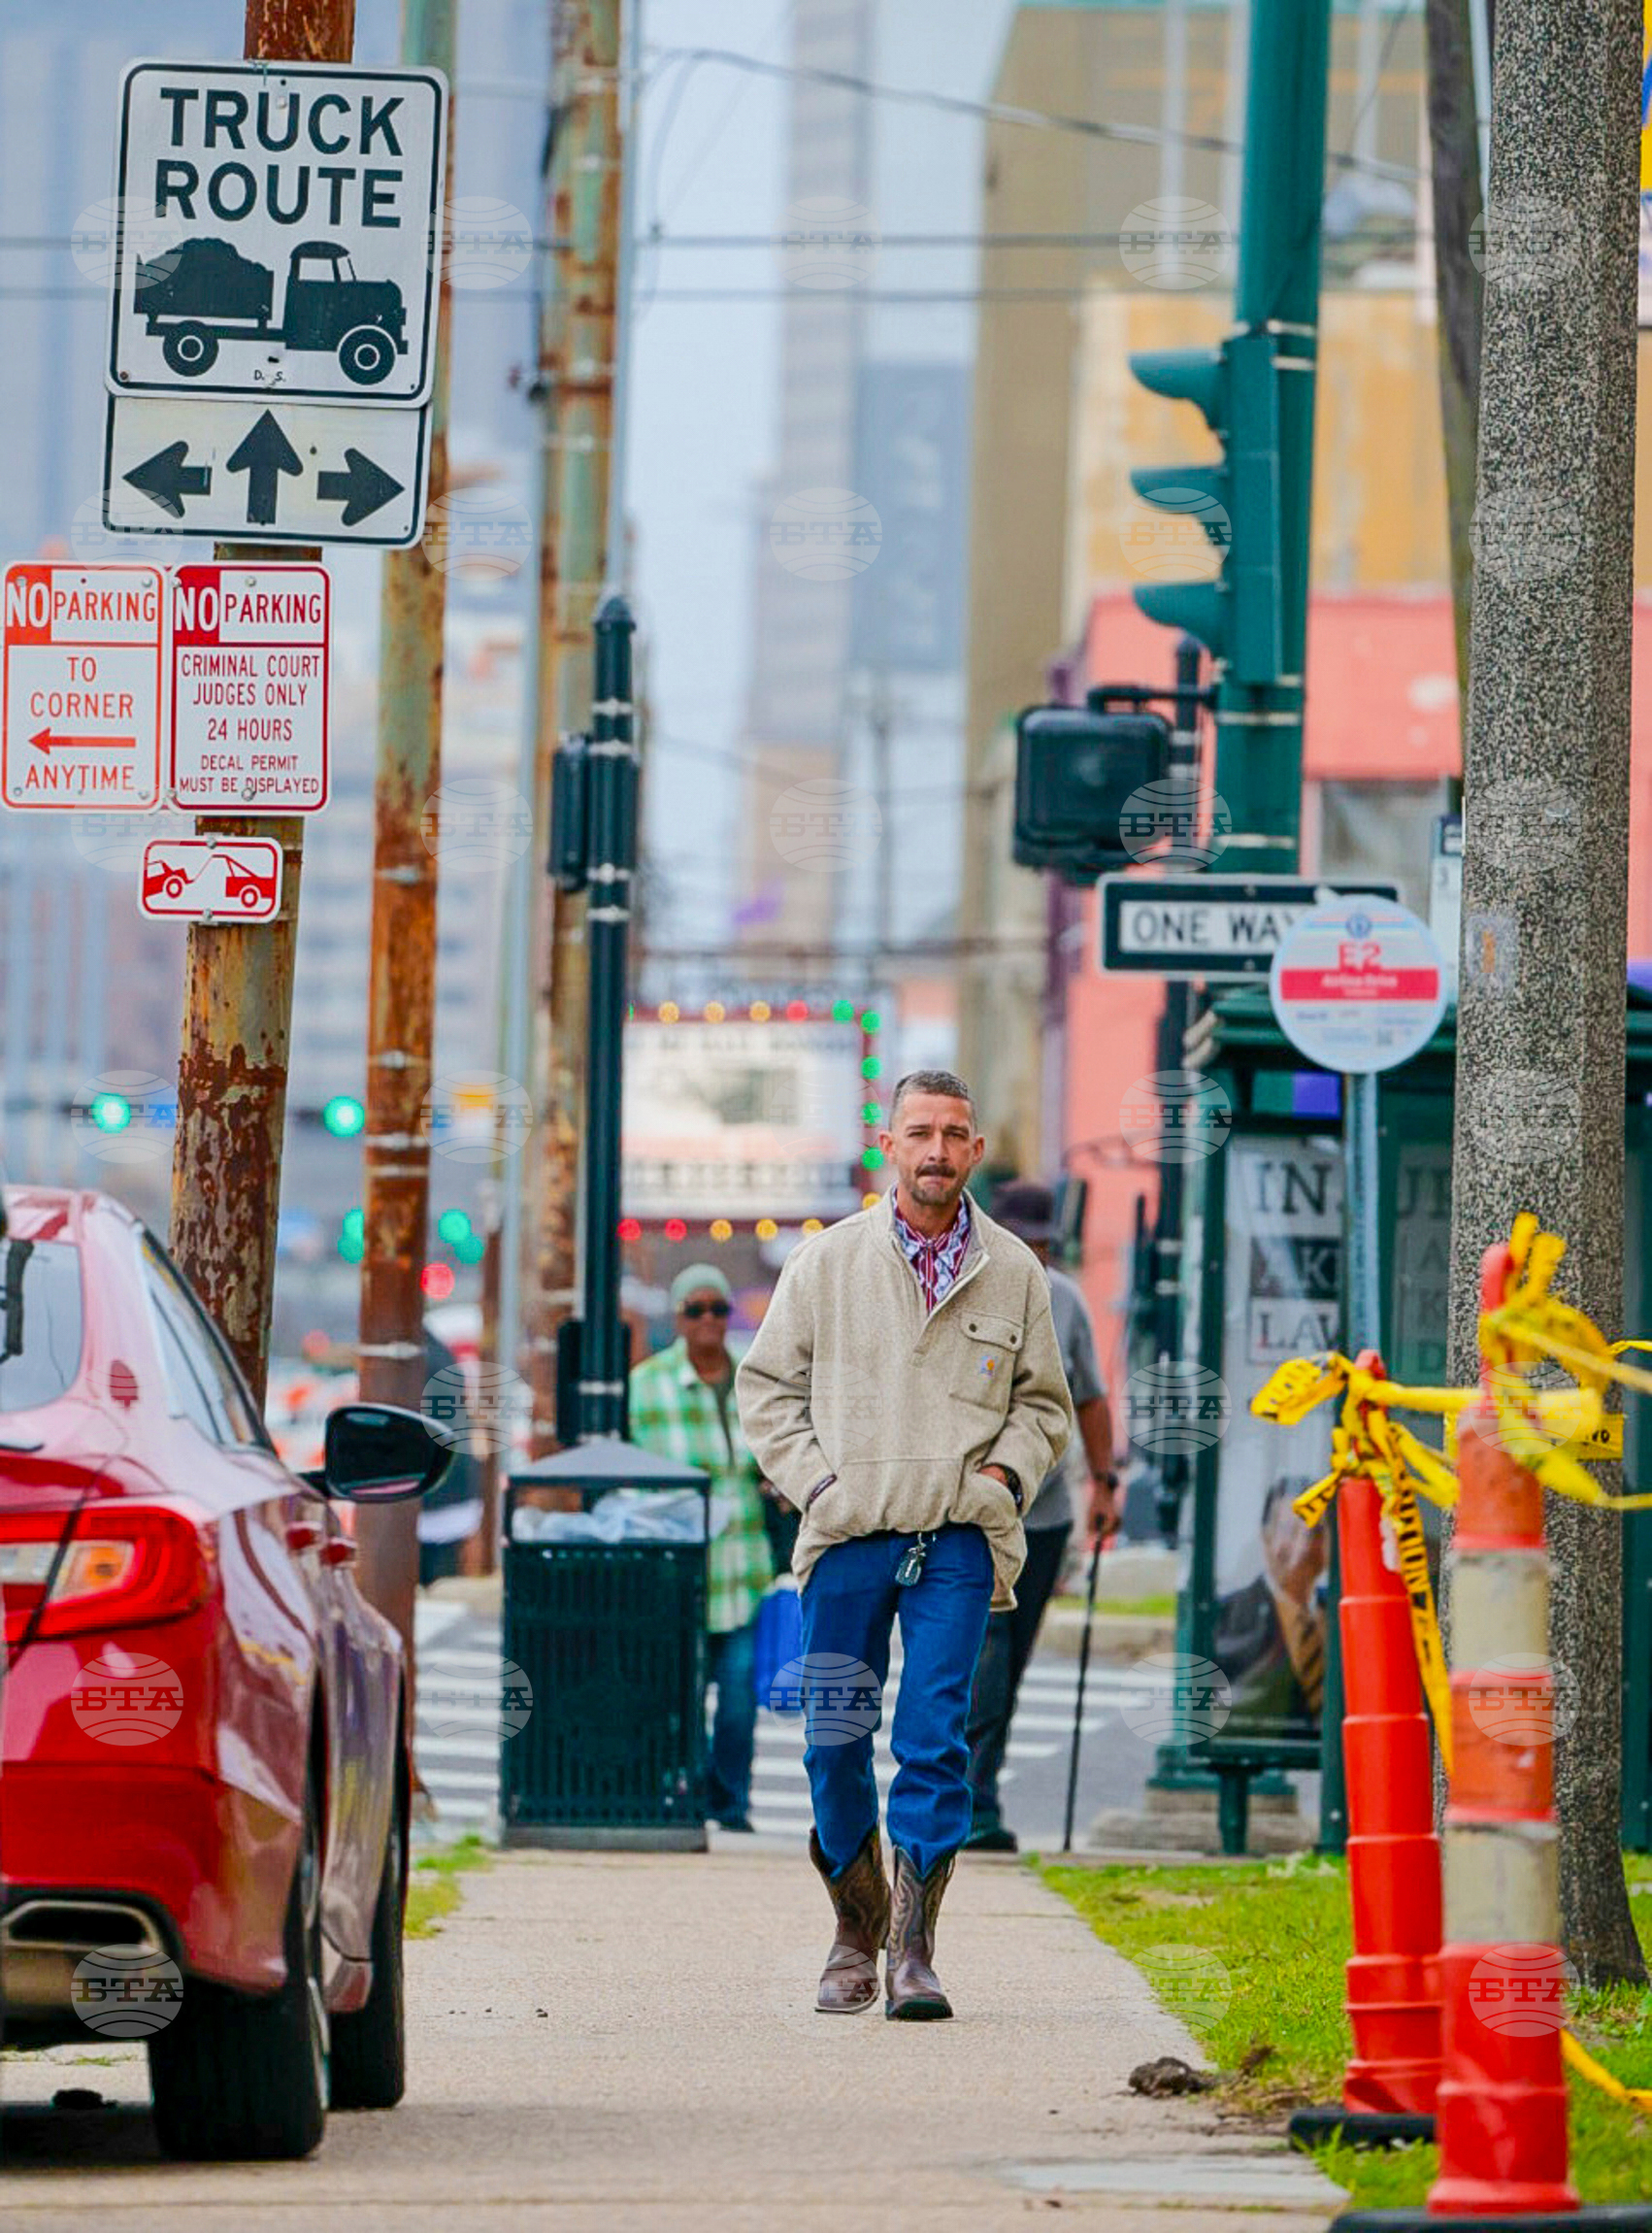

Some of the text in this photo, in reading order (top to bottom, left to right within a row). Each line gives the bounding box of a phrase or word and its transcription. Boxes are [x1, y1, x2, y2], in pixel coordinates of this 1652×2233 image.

[160, 87, 405, 156] TRUCK
[154, 158, 404, 228] ROUTE
[6, 582, 156, 628] NO PARKING
[175, 585, 322, 632] NO PARKING
[67, 657, 97, 682] TO
[182, 654, 320, 678] CRIMINAL COURT
[30, 692, 134, 719] CORNER
[193, 683, 308, 707] JUDGES ONLY
[207, 718, 292, 742] 24 HOURS
[200, 754, 299, 771] DECAL PERMIT
[25, 763, 135, 791] ANYTIME
[180, 777, 319, 794] MUST BE DISPLAYED
[1133, 908, 1210, 944] ONE
